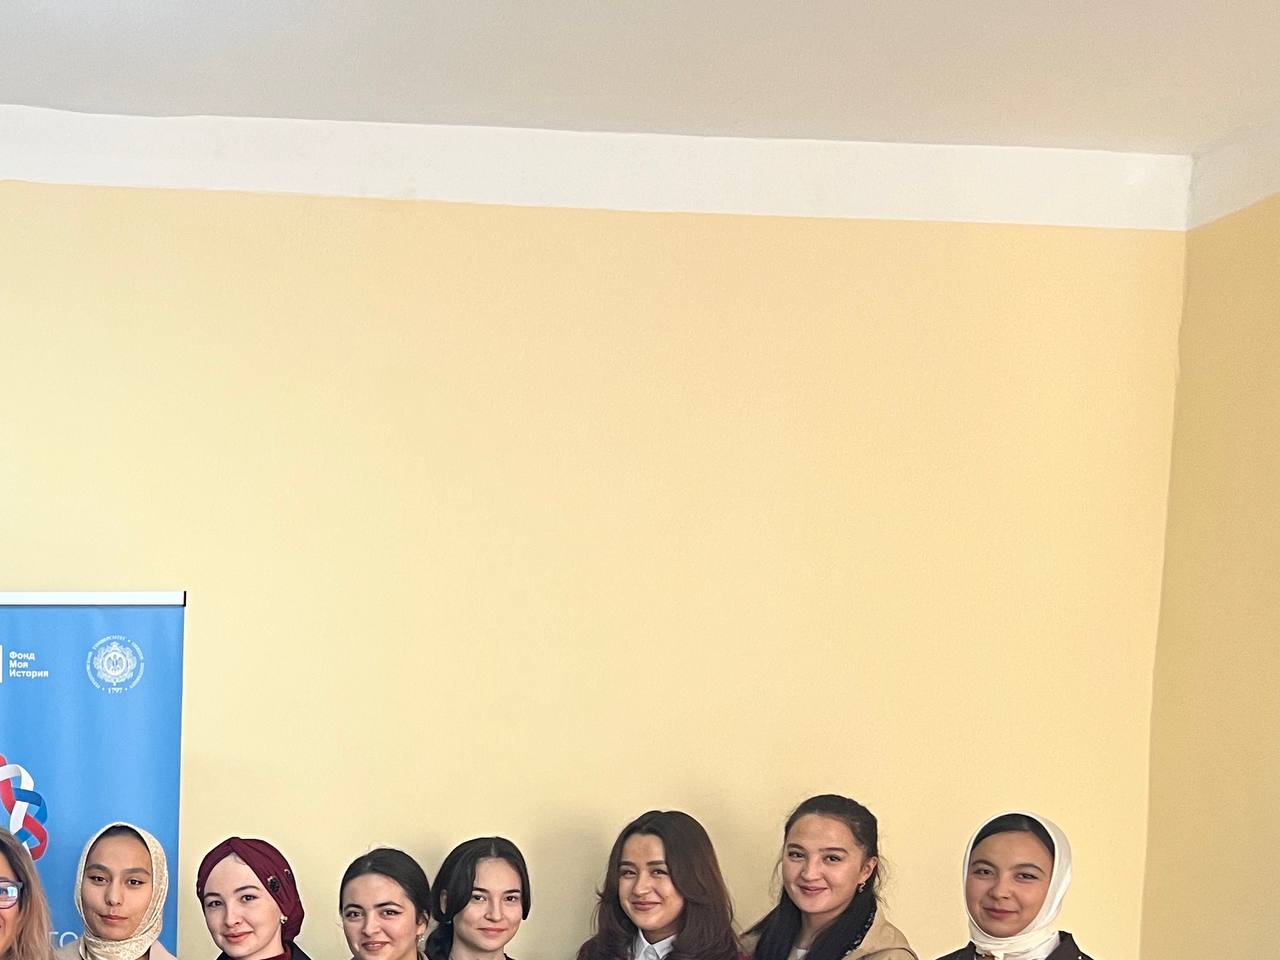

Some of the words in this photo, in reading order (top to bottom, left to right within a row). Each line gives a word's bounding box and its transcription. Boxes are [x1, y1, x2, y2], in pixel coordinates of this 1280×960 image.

[9, 651, 36, 661] Фонд
[9, 660, 29, 669] Моя
[9, 669, 49, 679] История
